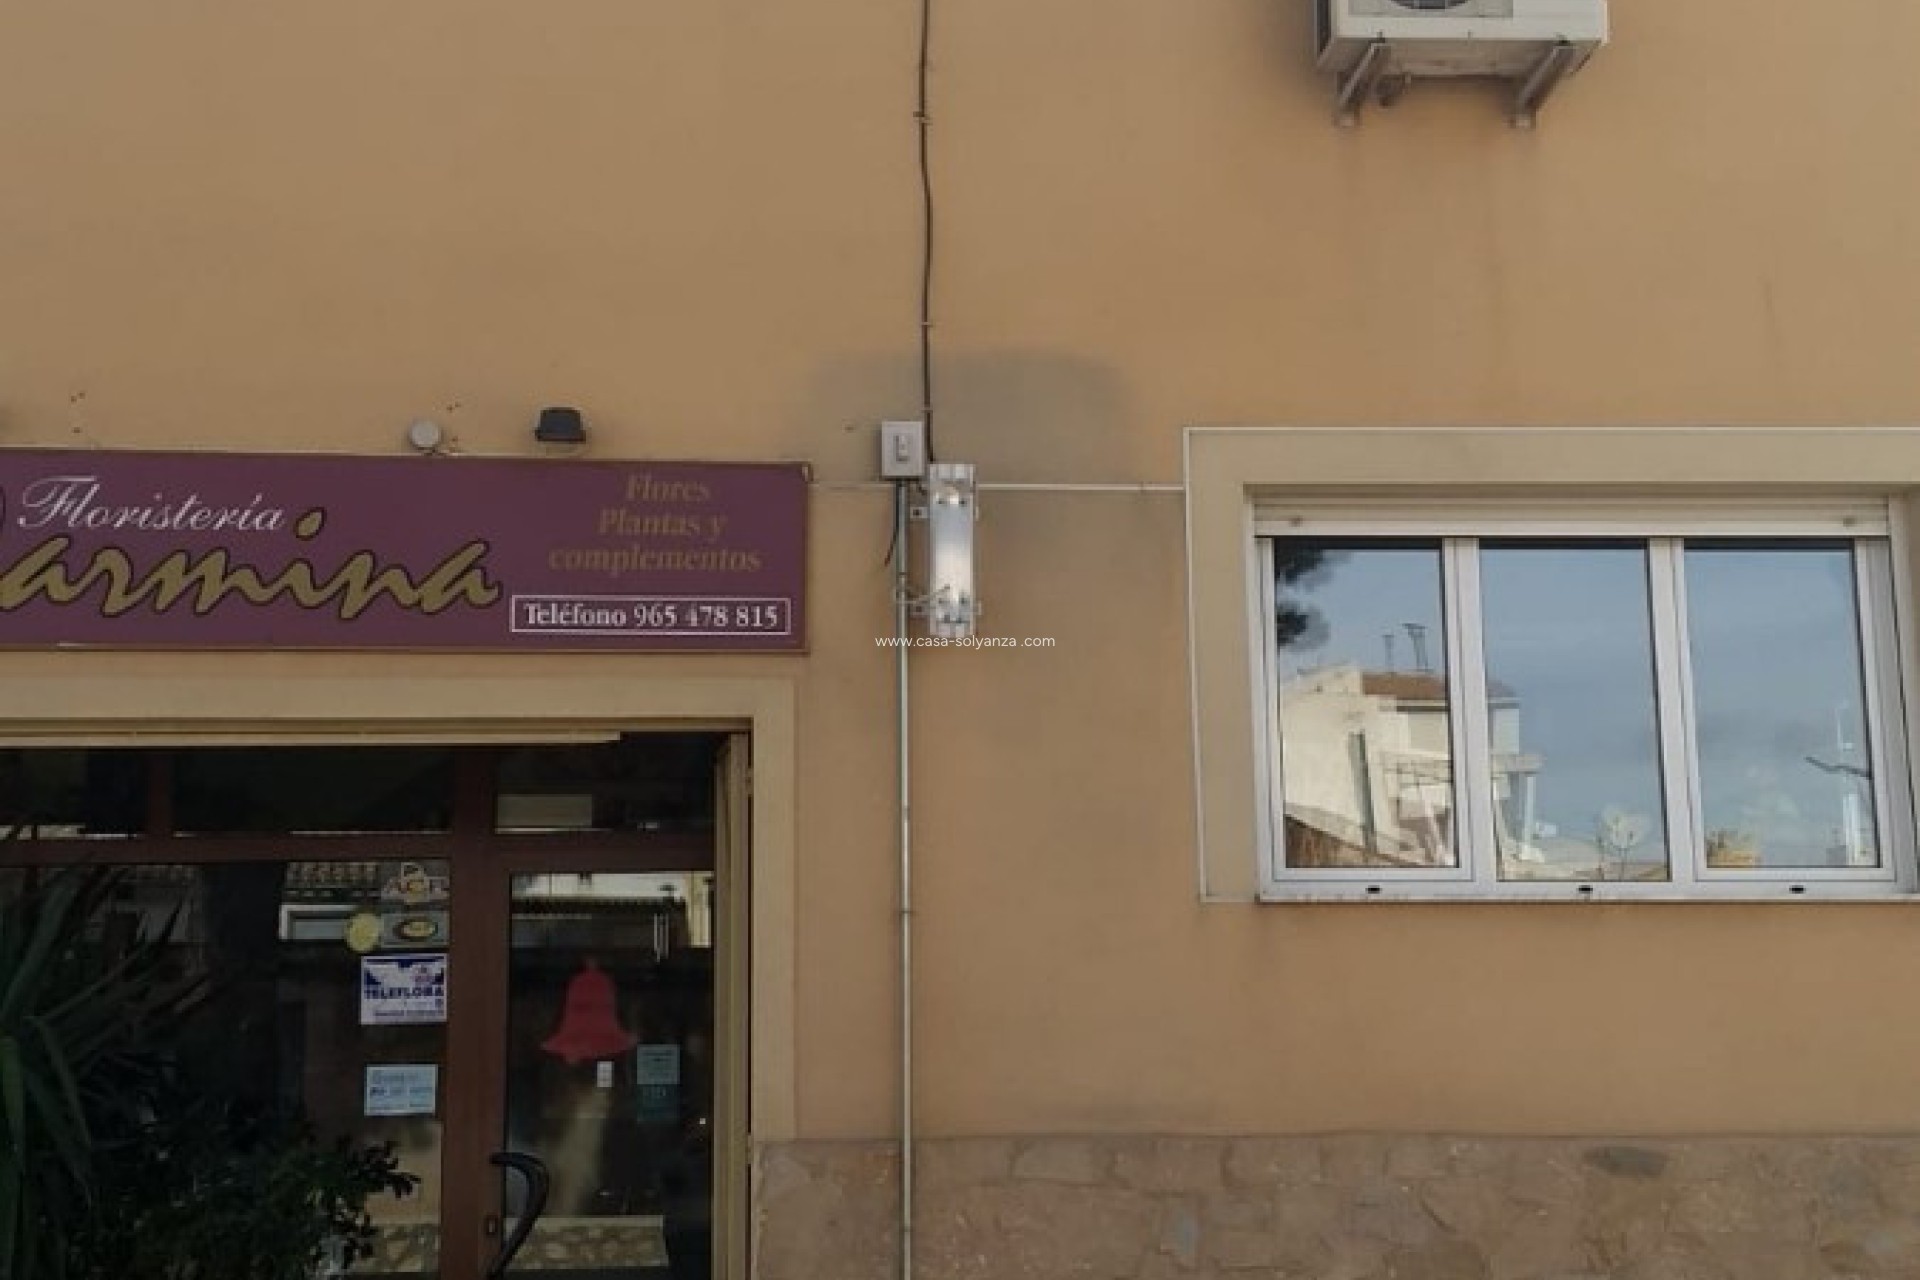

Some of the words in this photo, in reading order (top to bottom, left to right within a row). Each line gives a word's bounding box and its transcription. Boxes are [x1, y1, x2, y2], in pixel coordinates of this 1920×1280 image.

[18, 475, 284, 530] Floristería
[625, 474, 711, 501] Flores
[598, 507, 701, 535] Plantas
[704, 514, 727, 543] y
[0, 507, 503, 619] armina
[548, 543, 762, 577] complementos
[524, 602, 627, 627] Teléfono
[633, 603, 678, 628] 965
[685, 605, 729, 628] 478
[736, 605, 779, 629] 815
